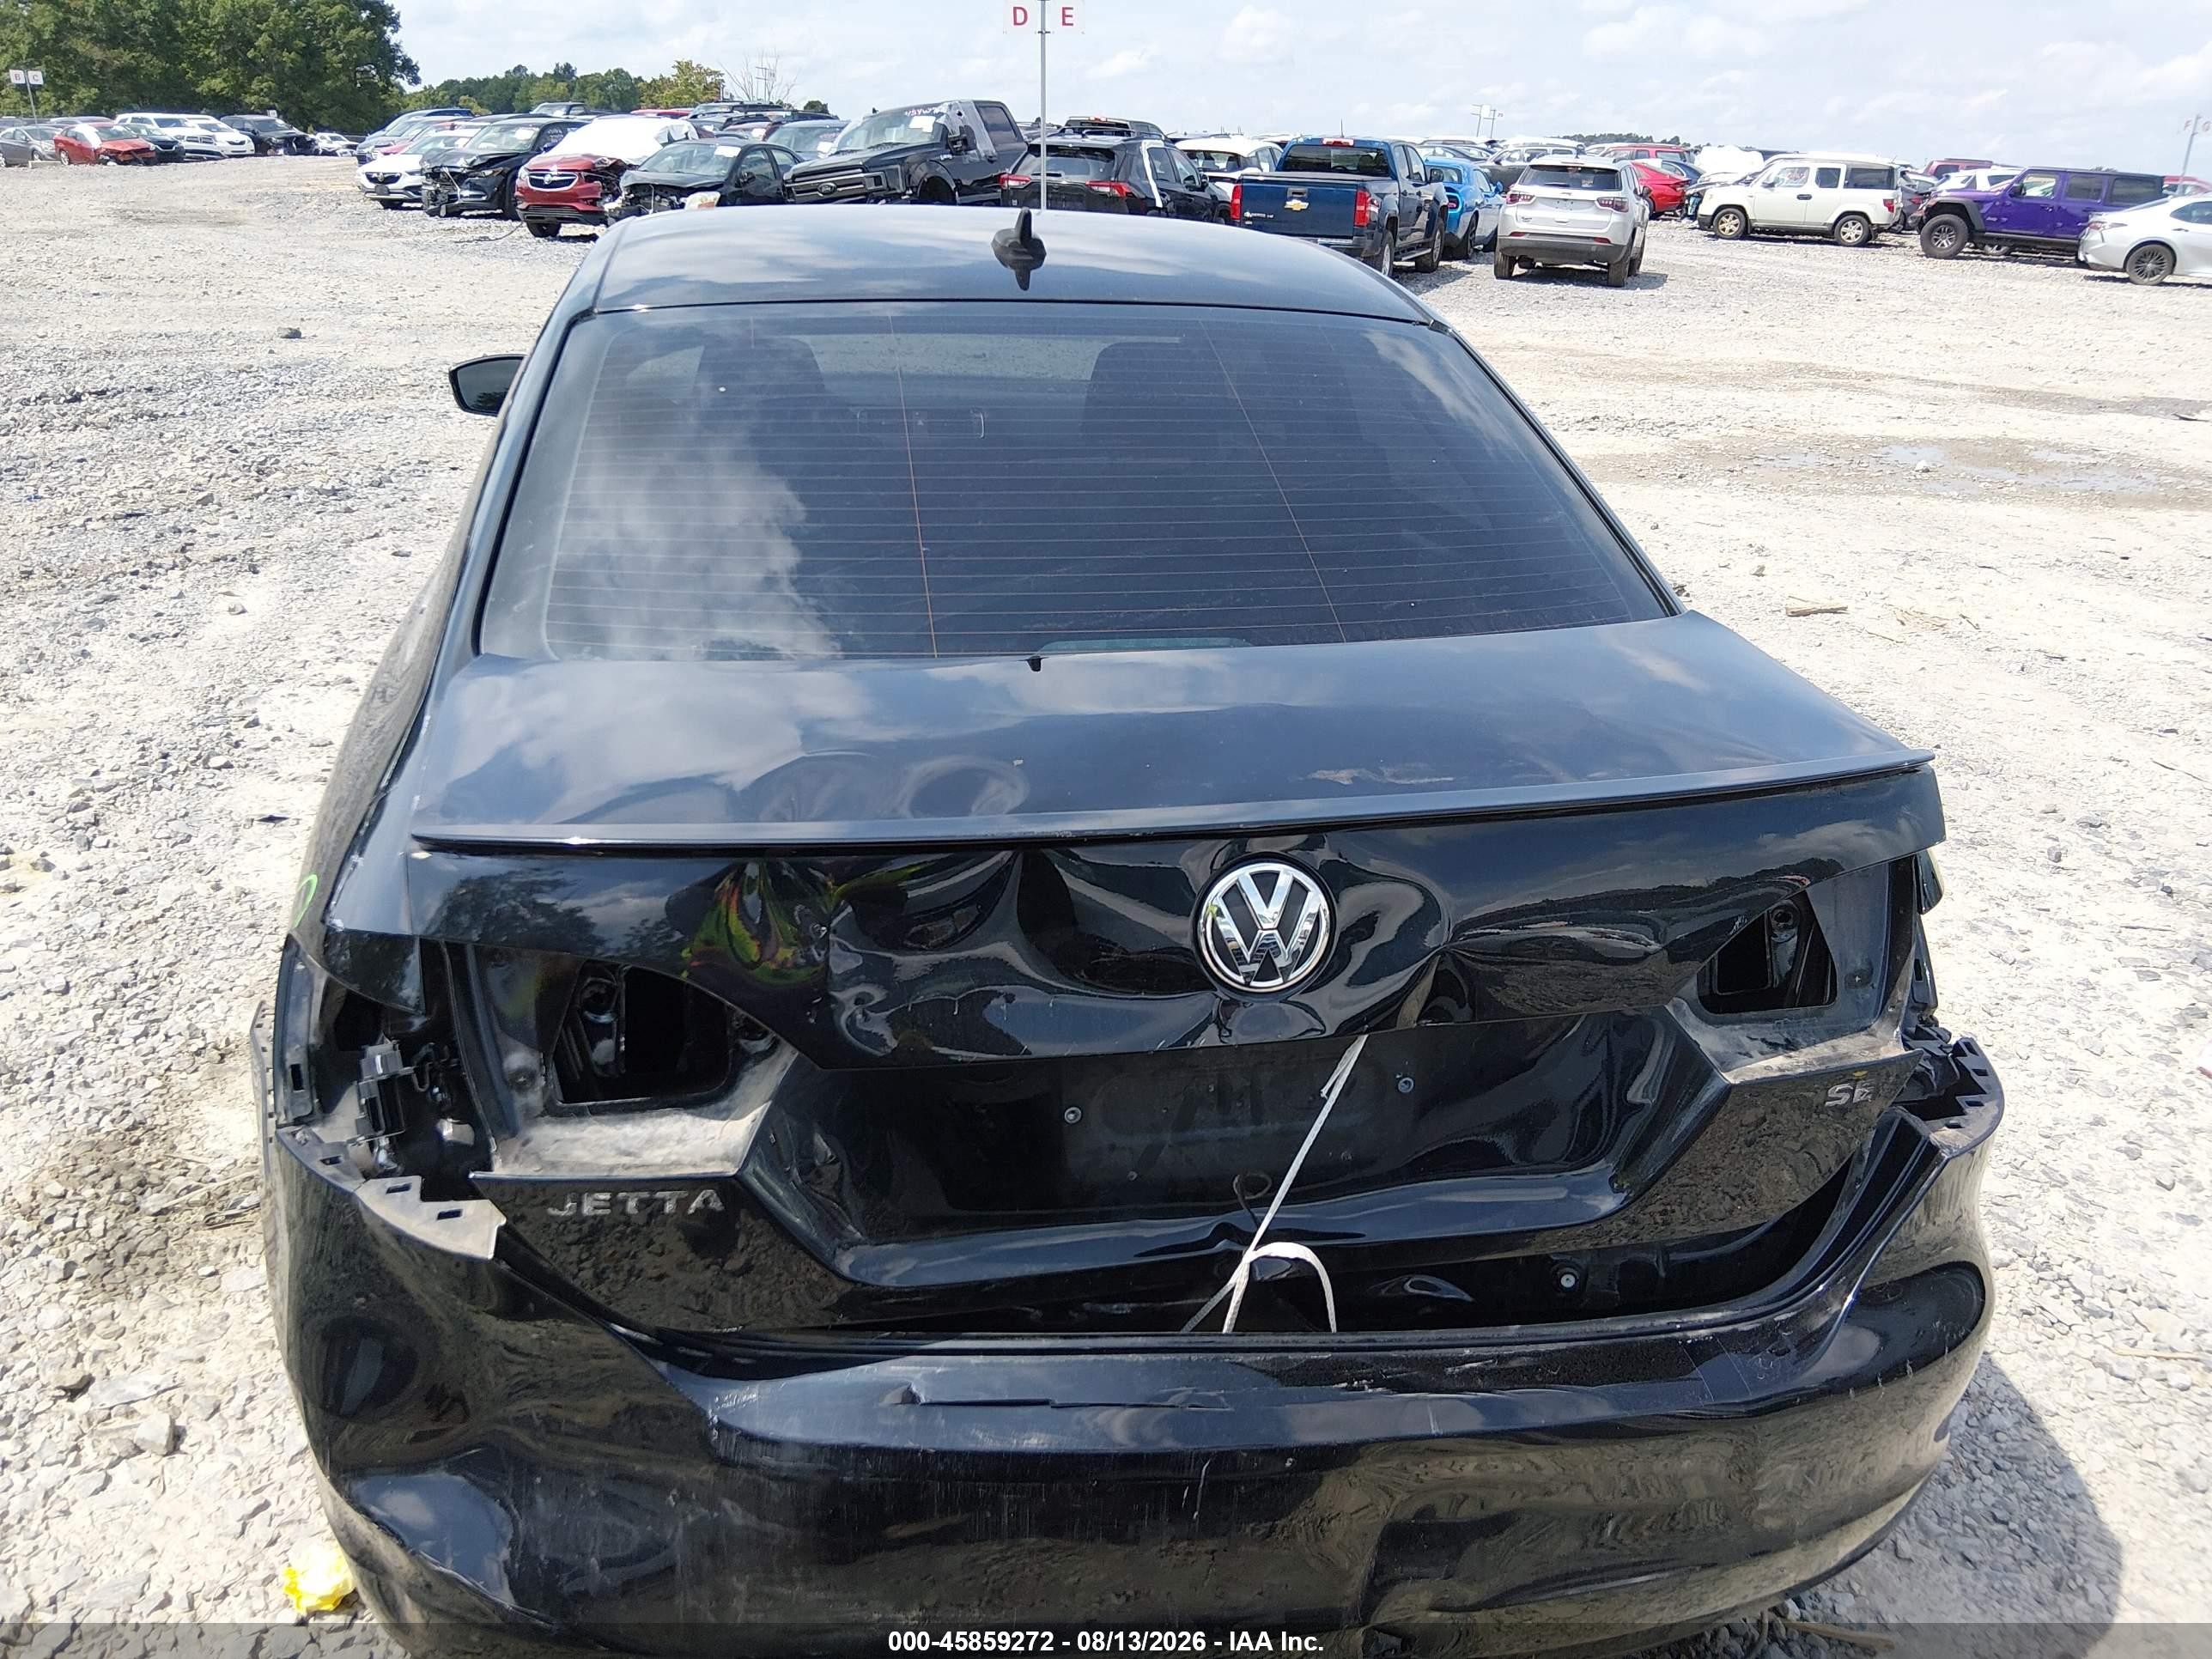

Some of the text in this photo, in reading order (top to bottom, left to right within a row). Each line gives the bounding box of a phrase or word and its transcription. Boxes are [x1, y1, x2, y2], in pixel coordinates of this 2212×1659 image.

[1012, 6, 1029, 26] D
[1061, 6, 1074, 26] E
[1204, 866, 1326, 989] VW
[546, 1188, 726, 1217] JETTA
